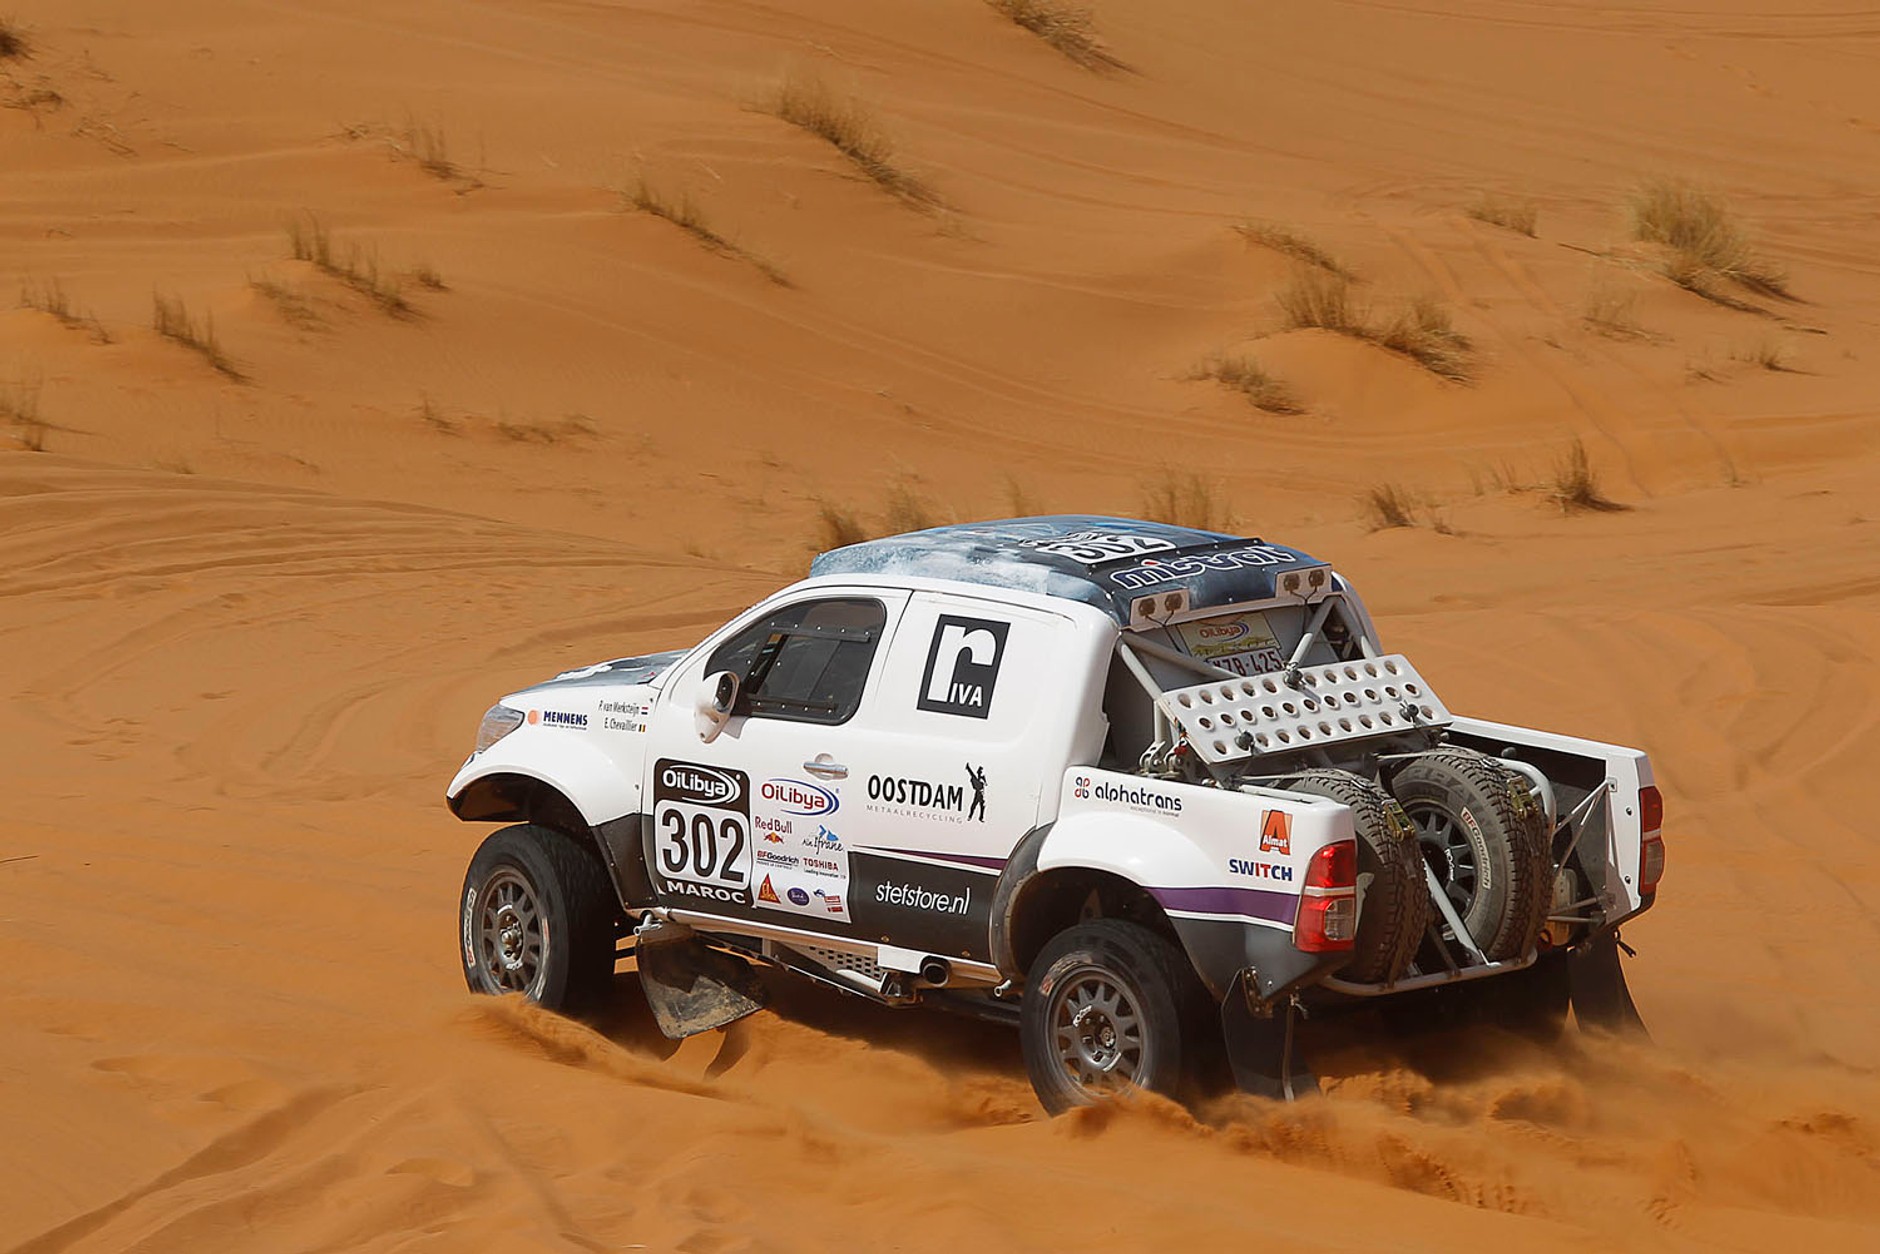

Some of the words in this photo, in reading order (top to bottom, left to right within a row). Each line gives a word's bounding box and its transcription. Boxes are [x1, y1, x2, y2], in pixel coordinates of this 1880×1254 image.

[543, 710, 588, 726] MENNENS
[663, 770, 726, 796] OiLibya
[867, 774, 963, 812] OOSTDAM
[761, 783, 825, 810] OiLibya
[1095, 781, 1182, 811] alphatrans
[755, 816, 774, 831] Red
[774, 819, 793, 834] Bull
[866, 804, 963, 824] METAALRECYCLING
[662, 809, 744, 883] 302
[757, 850, 799, 864] BFGoodrich
[803, 857, 839, 871] TOSHIBA
[1229, 858, 1293, 881] SWITCH
[666, 880, 746, 904] MAROC
[875, 881, 971, 915] stefstore.nl
